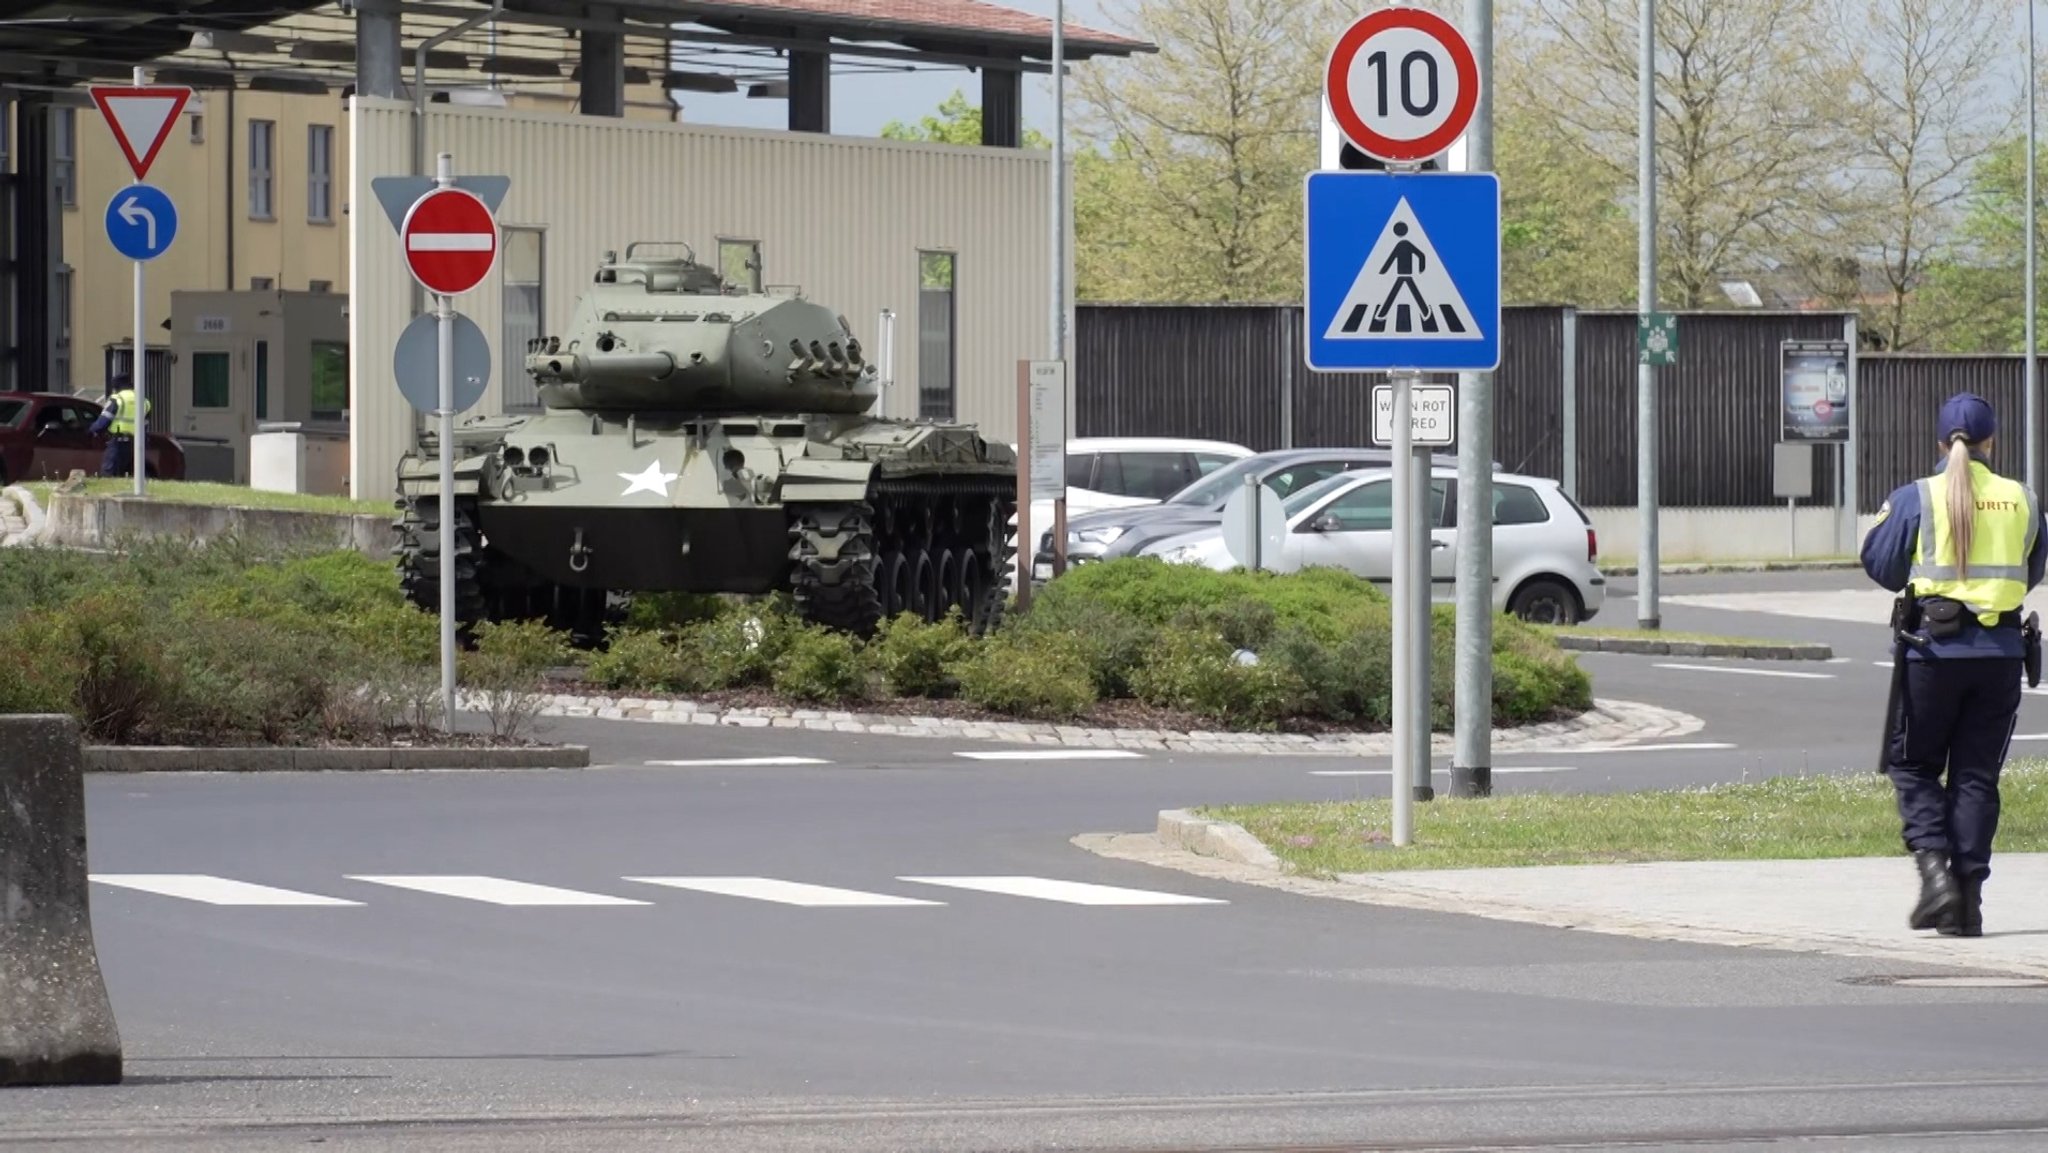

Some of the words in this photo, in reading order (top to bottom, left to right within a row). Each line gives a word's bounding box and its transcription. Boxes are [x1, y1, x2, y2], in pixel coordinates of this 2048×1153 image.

[1368, 49, 1438, 117] 10
[1380, 400, 1418, 411] WN
[1422, 400, 1447, 411] ROT
[1411, 417, 1437, 429] RED
[1975, 501, 2019, 513] URITY
